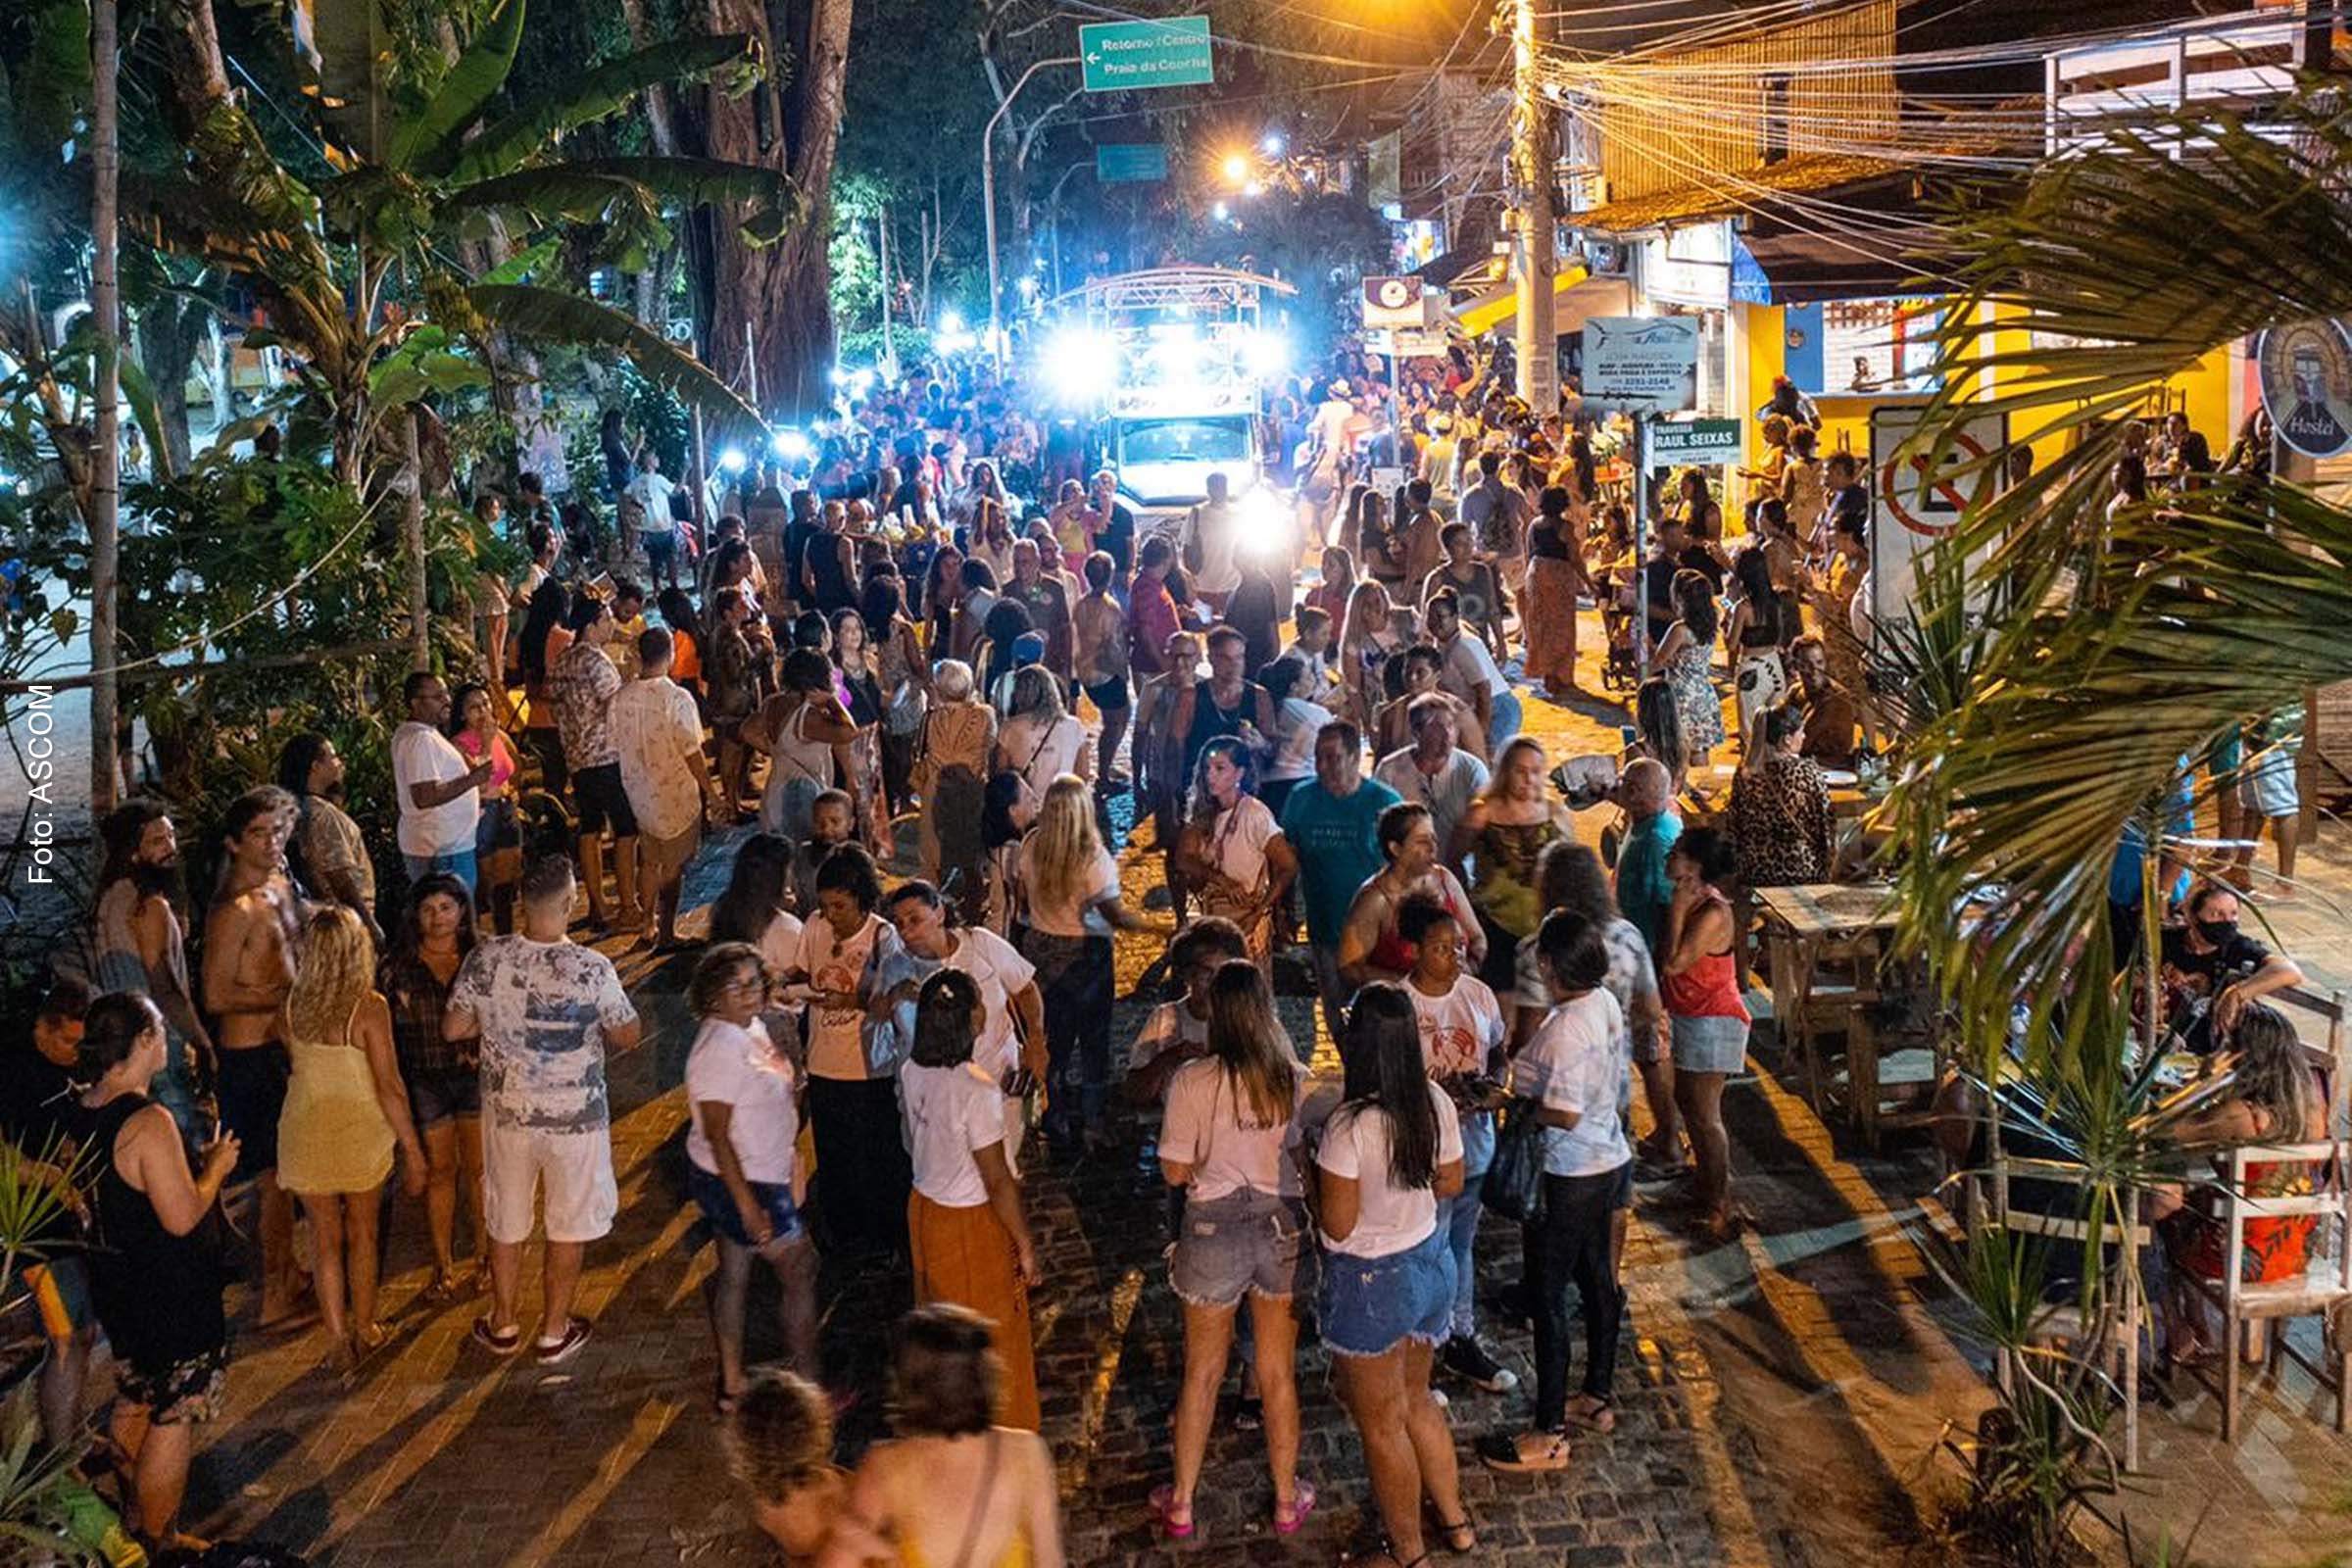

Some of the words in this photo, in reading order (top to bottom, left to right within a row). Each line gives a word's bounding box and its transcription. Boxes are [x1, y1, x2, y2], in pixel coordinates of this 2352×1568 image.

[1102, 37, 1154, 51] Retorno
[1162, 33, 1207, 47] Centro
[1104, 63, 1138, 75] Praia
[1141, 62, 1157, 73] da
[2290, 416, 2334, 436] Hostel
[1655, 434, 1688, 448] RAUL
[1689, 431, 1734, 447] SEIXAS
